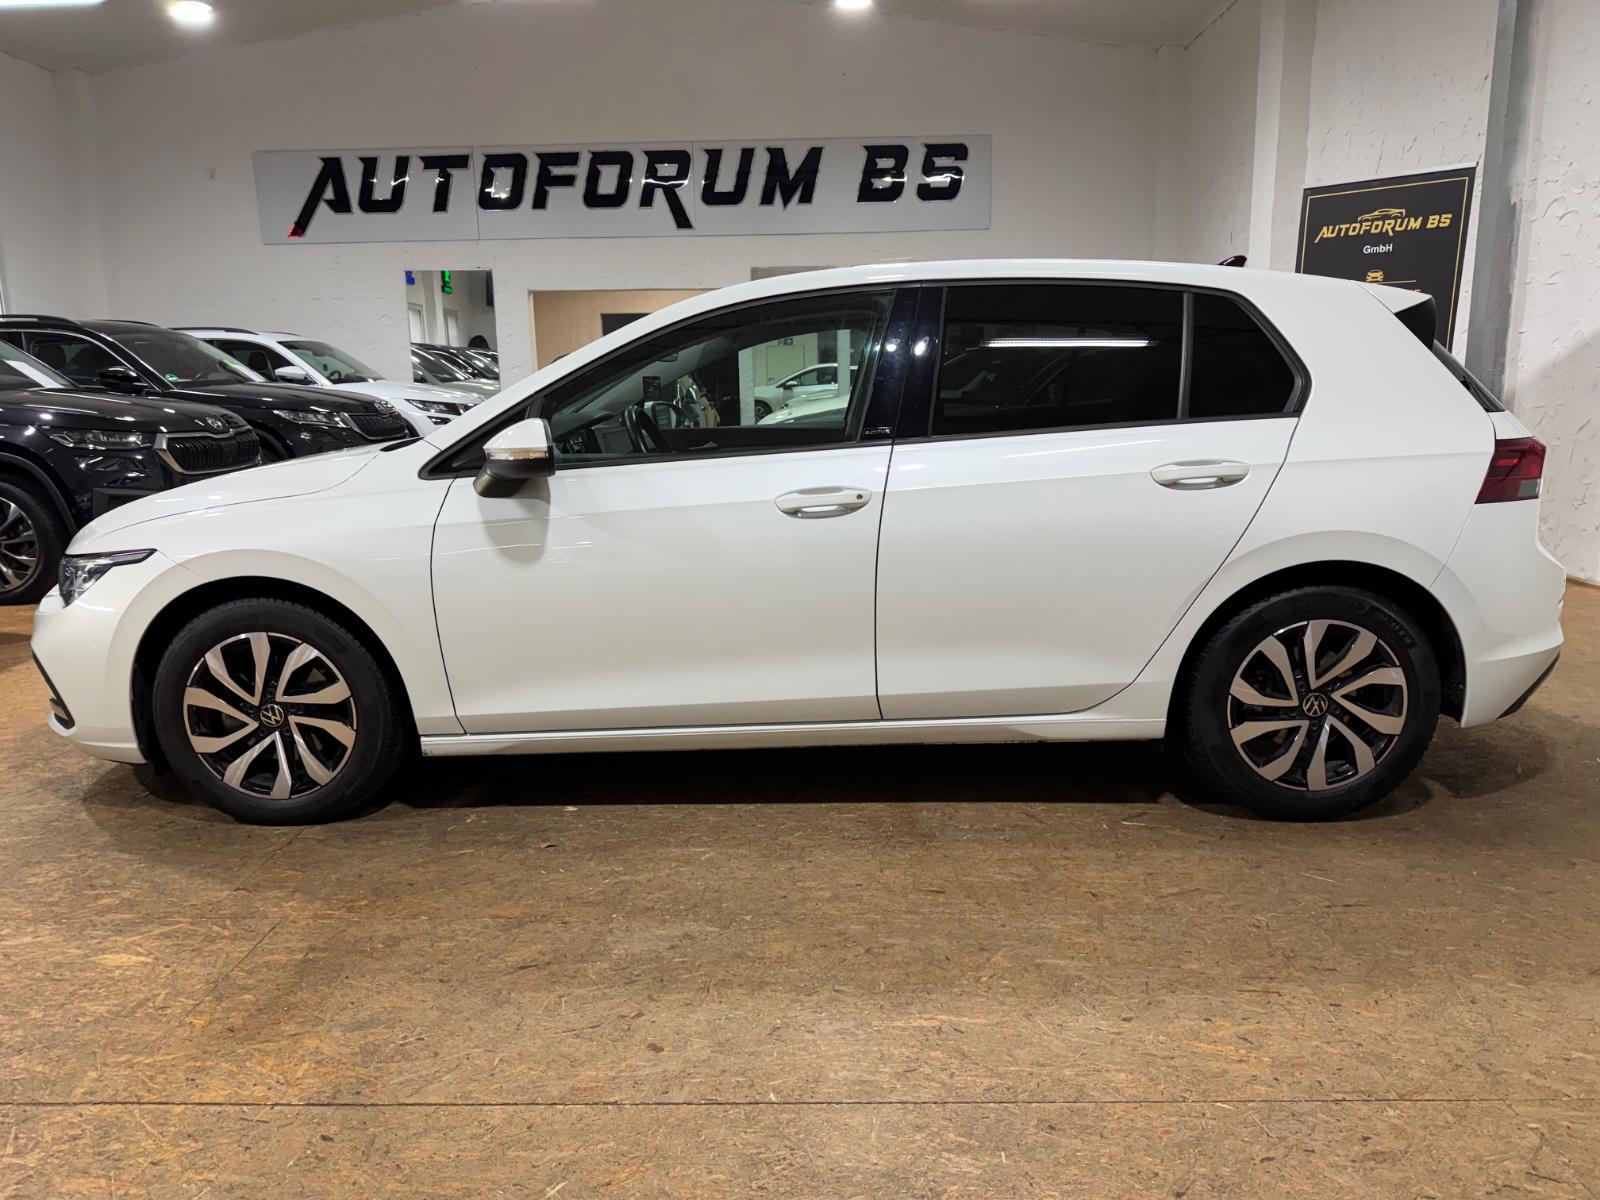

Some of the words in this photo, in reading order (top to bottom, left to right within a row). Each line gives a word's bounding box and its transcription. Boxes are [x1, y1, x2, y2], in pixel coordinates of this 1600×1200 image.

[288, 147, 824, 237] AUTOFORUM
[1314, 216, 1423, 243] AUTOFORUM
[1363, 243, 1393, 254] GmbH
